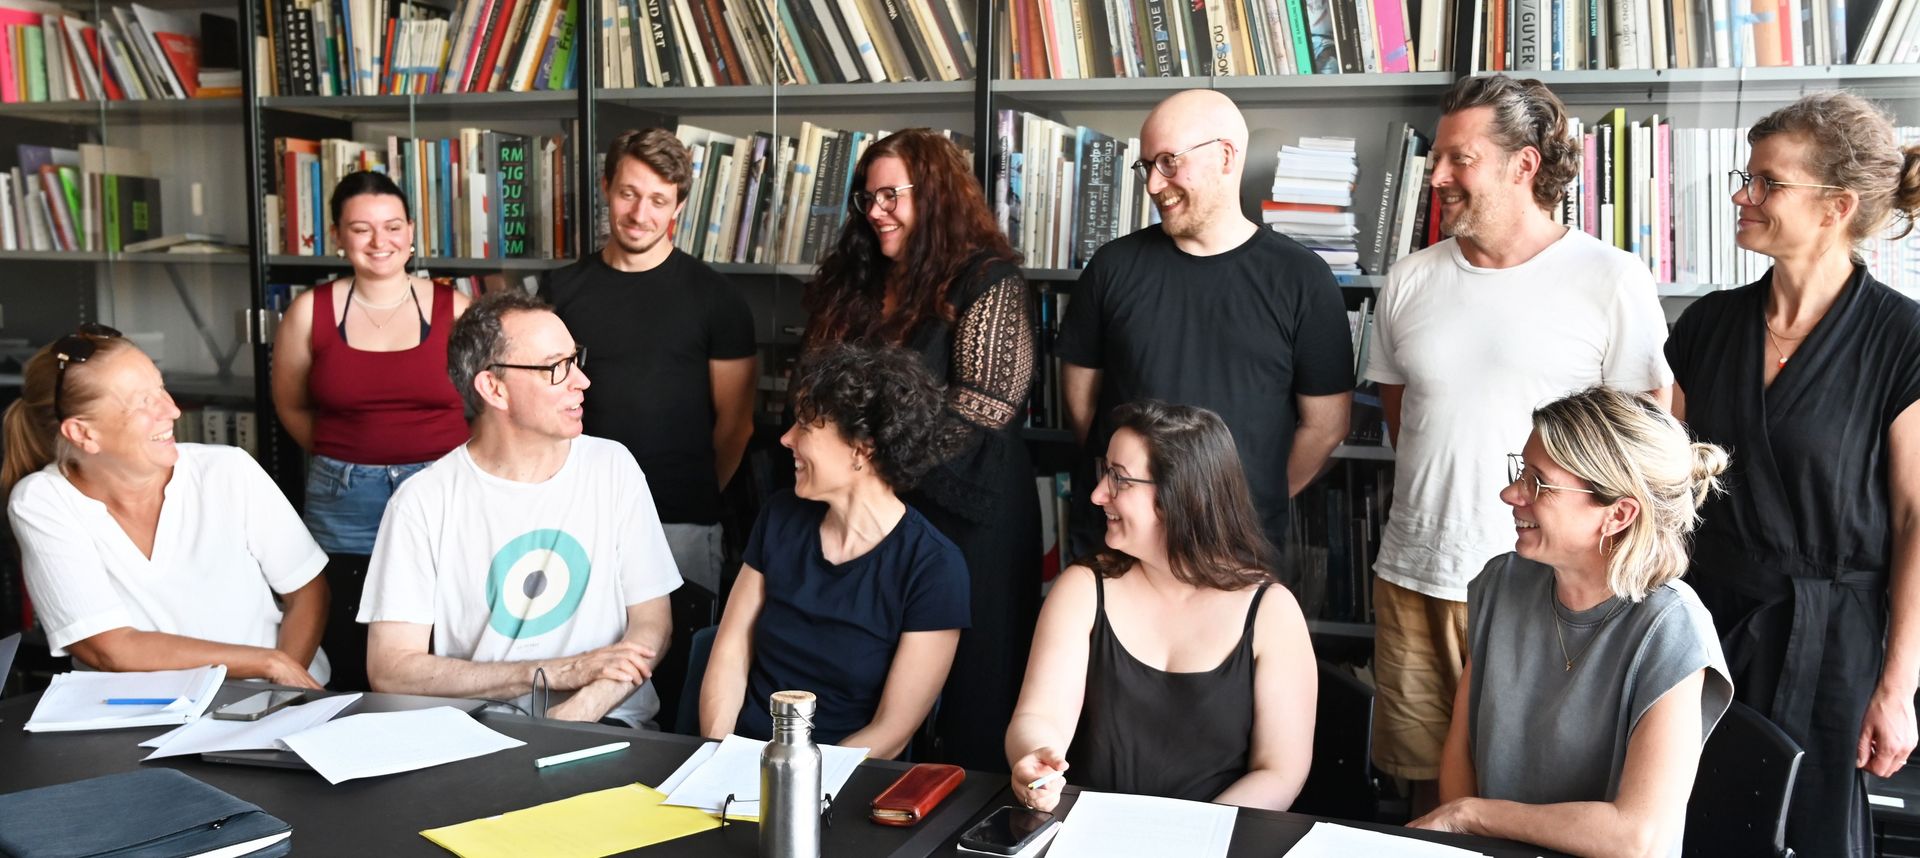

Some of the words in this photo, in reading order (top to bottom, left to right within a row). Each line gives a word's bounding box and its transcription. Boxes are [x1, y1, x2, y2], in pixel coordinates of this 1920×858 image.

[1151, 6, 1168, 51] BLAUE
[1521, 0, 1536, 65] /GUYER
[1622, 0, 1630, 21] SNO
[652, 22, 667, 48] ART
[1213, 24, 1229, 77] MOSCOU
[1091, 141, 1101, 185] gruppe
[1103, 141, 1114, 177] group
[1385, 171, 1393, 187] ART
[1087, 191, 1098, 235] wiener
